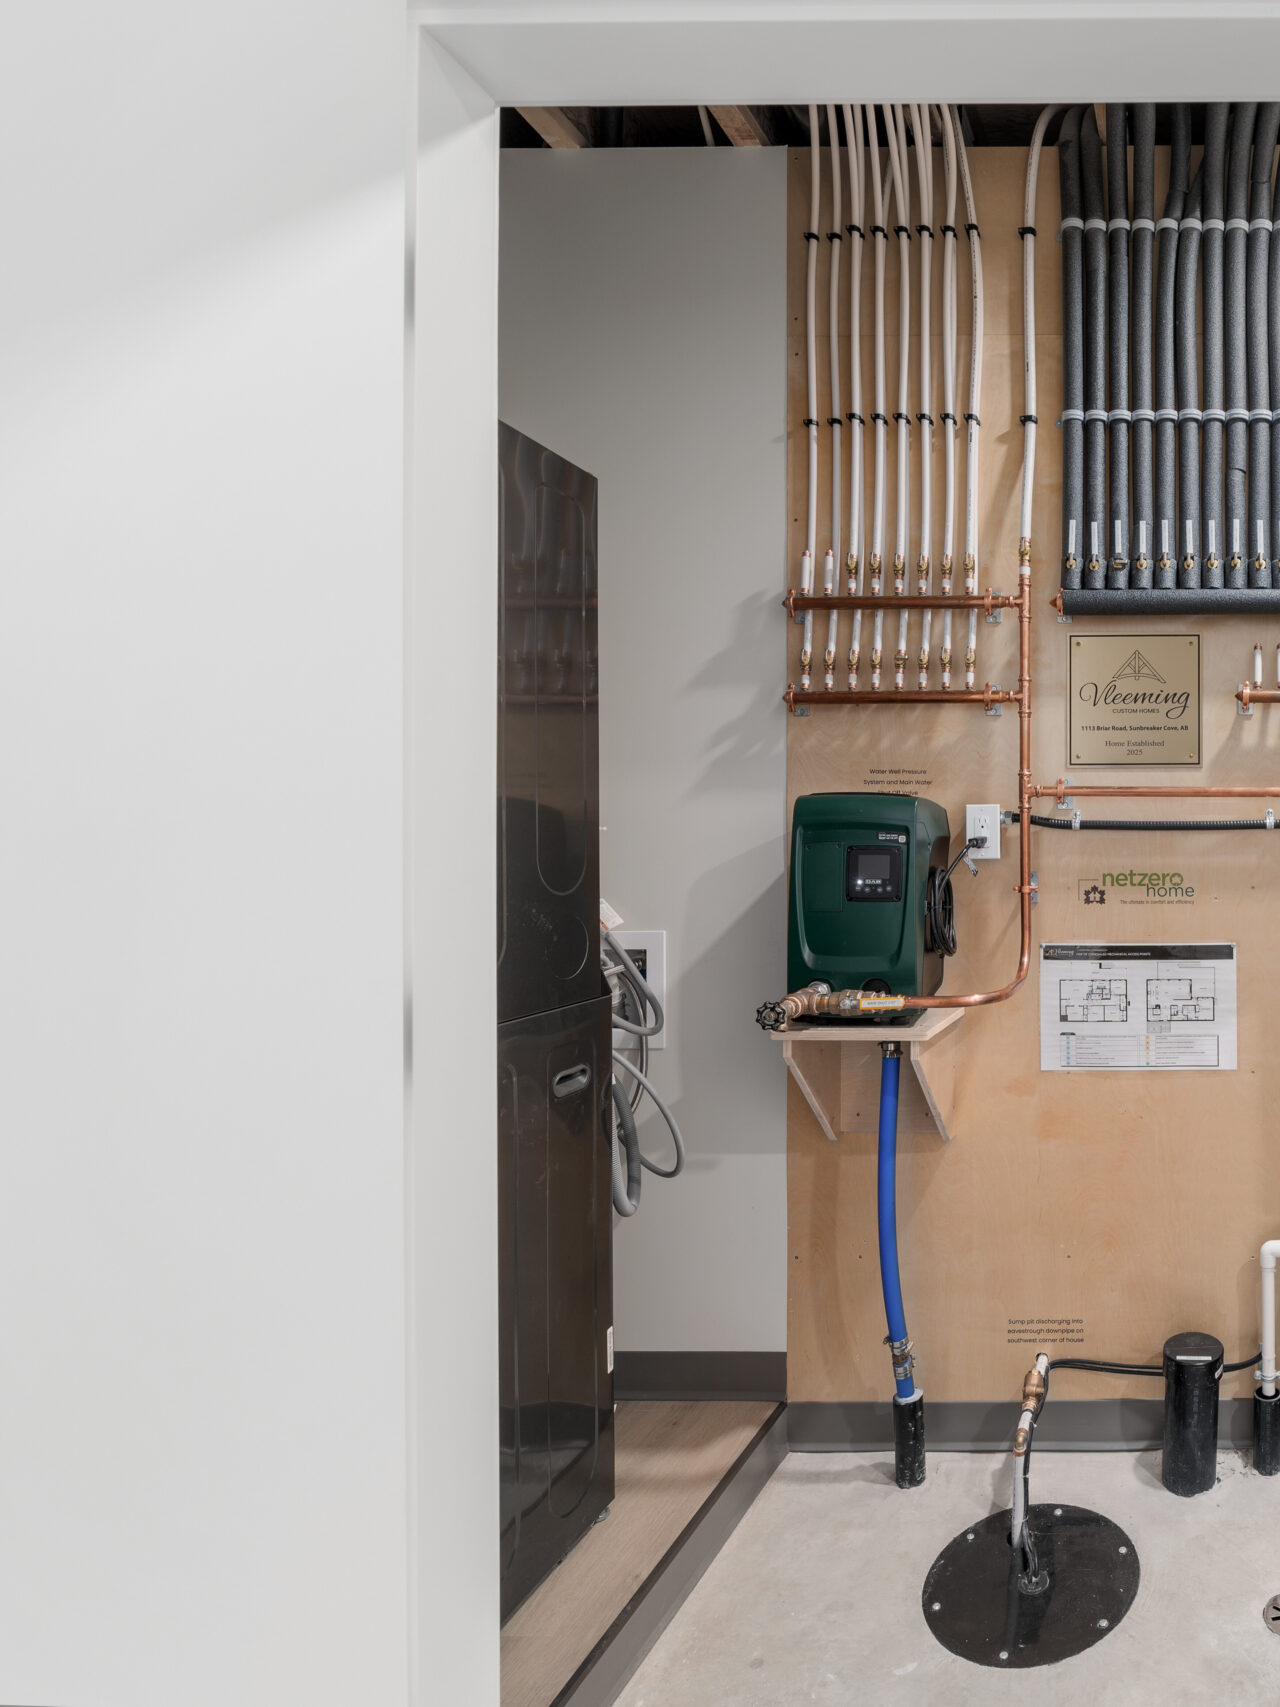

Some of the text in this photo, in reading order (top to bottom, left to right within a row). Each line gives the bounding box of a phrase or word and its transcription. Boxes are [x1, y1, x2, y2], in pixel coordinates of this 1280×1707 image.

[1079, 679, 1191, 719] Vleeming
[1102, 869, 1184, 887] netzero
[1146, 883, 1195, 897] home
